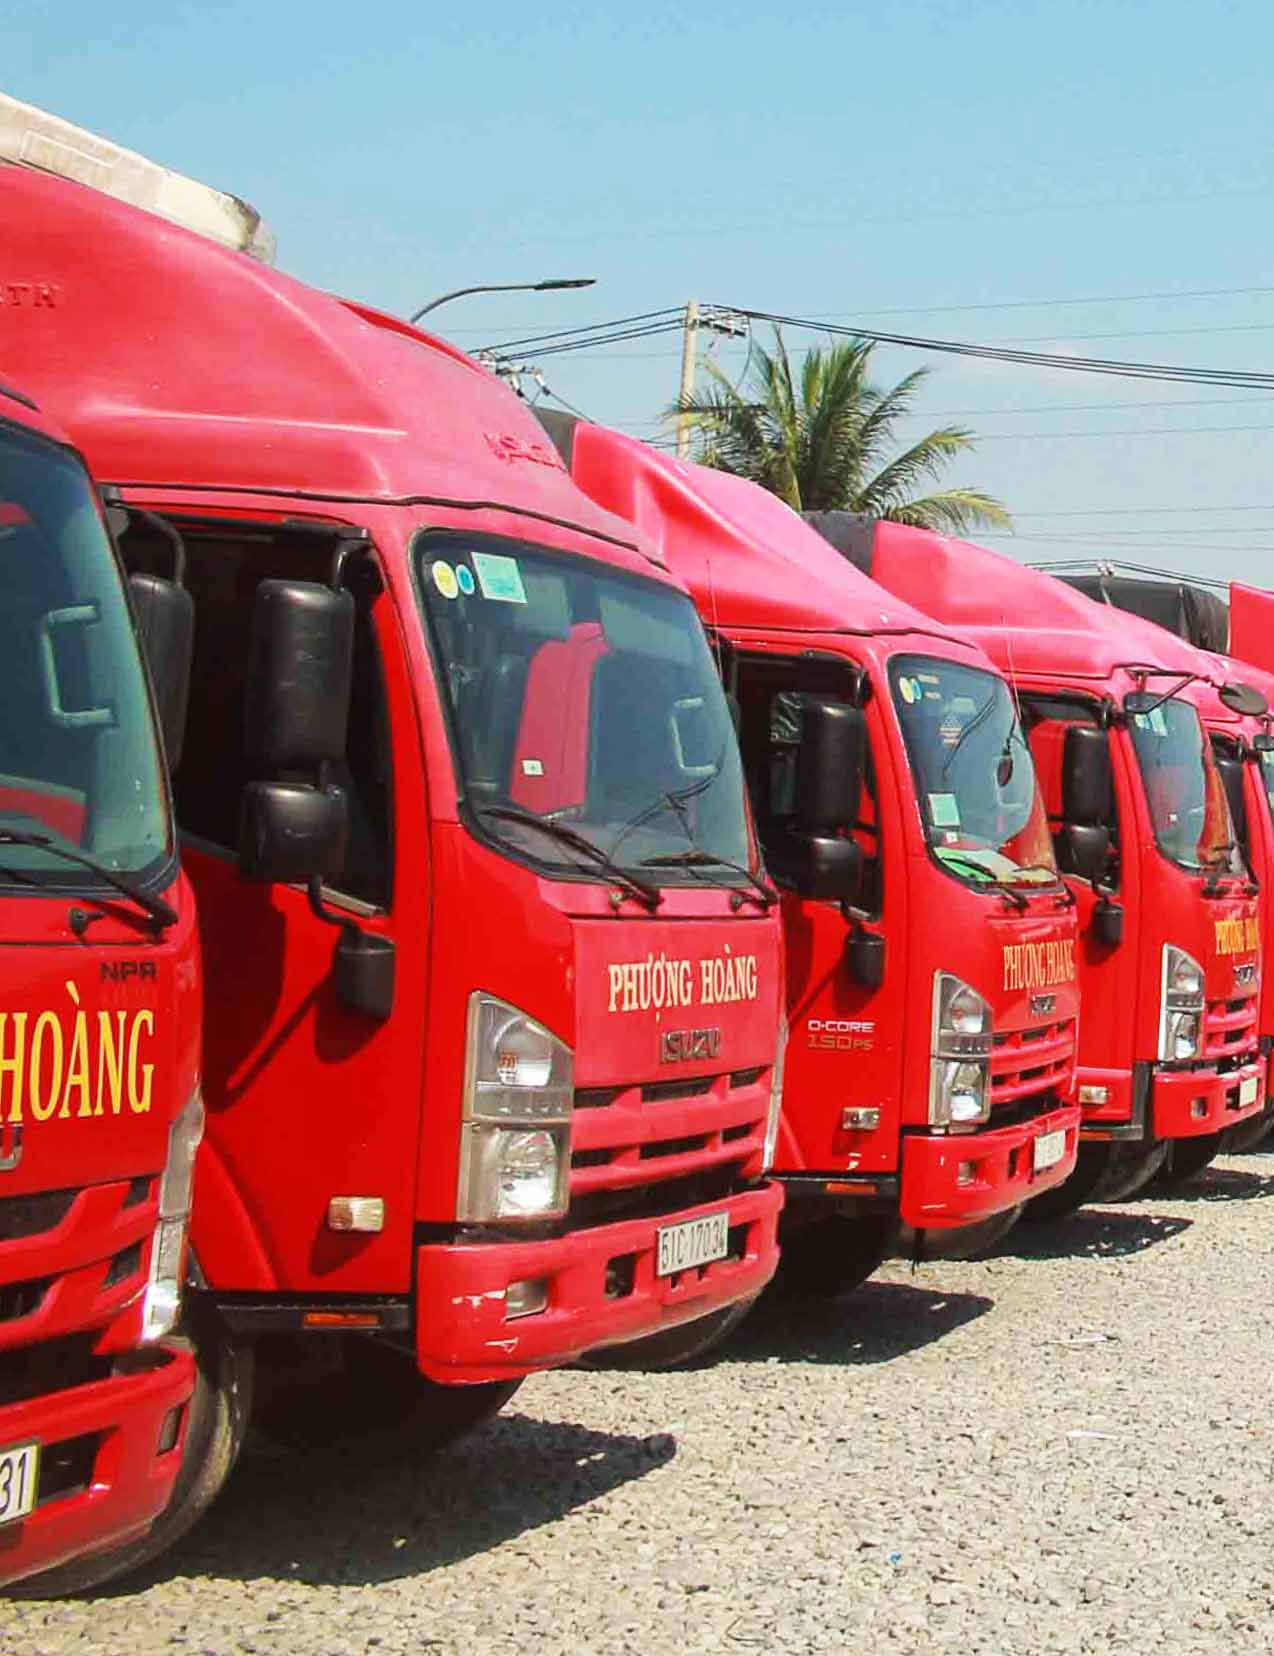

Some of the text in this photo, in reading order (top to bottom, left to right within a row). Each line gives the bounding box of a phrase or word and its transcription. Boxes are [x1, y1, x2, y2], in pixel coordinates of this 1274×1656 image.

[101, 961, 157, 981] NPR
[607, 943, 758, 1024] PHƯỢNG HOÀNG
[661, 1026, 720, 1064] ISUZU
